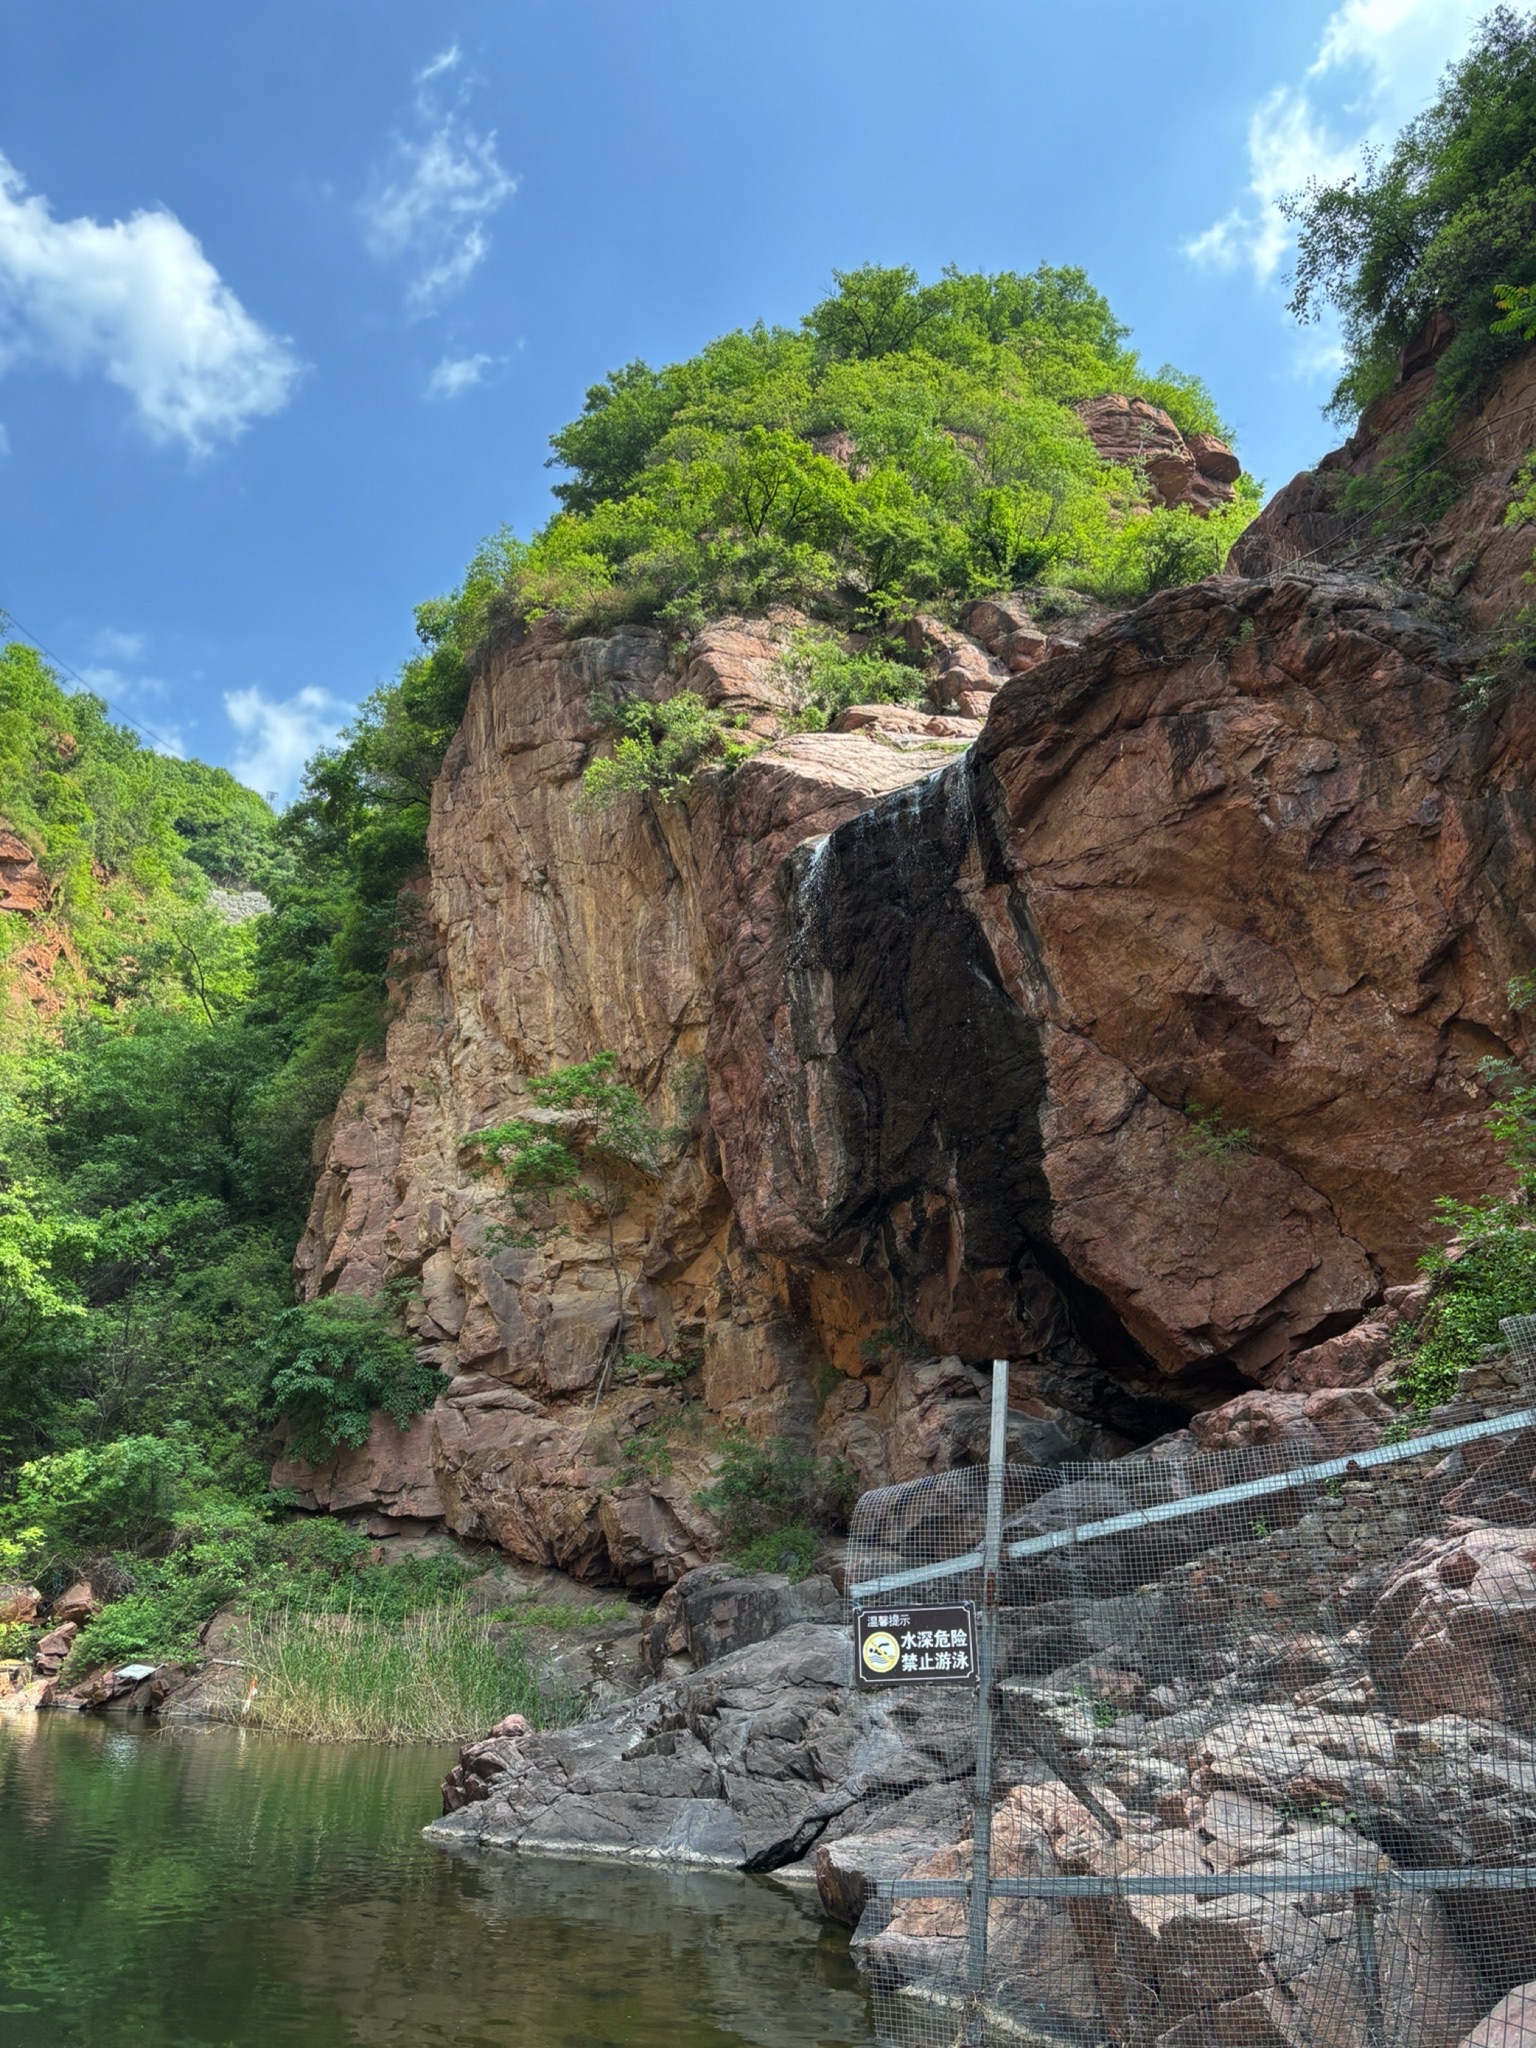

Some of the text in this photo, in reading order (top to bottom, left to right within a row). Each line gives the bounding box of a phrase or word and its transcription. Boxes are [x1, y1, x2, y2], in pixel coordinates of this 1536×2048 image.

[867, 1614, 911, 1628] 温馨提示
[901, 1628, 968, 1650] 水深危险
[901, 1651, 969, 1672] 禁止游泳
